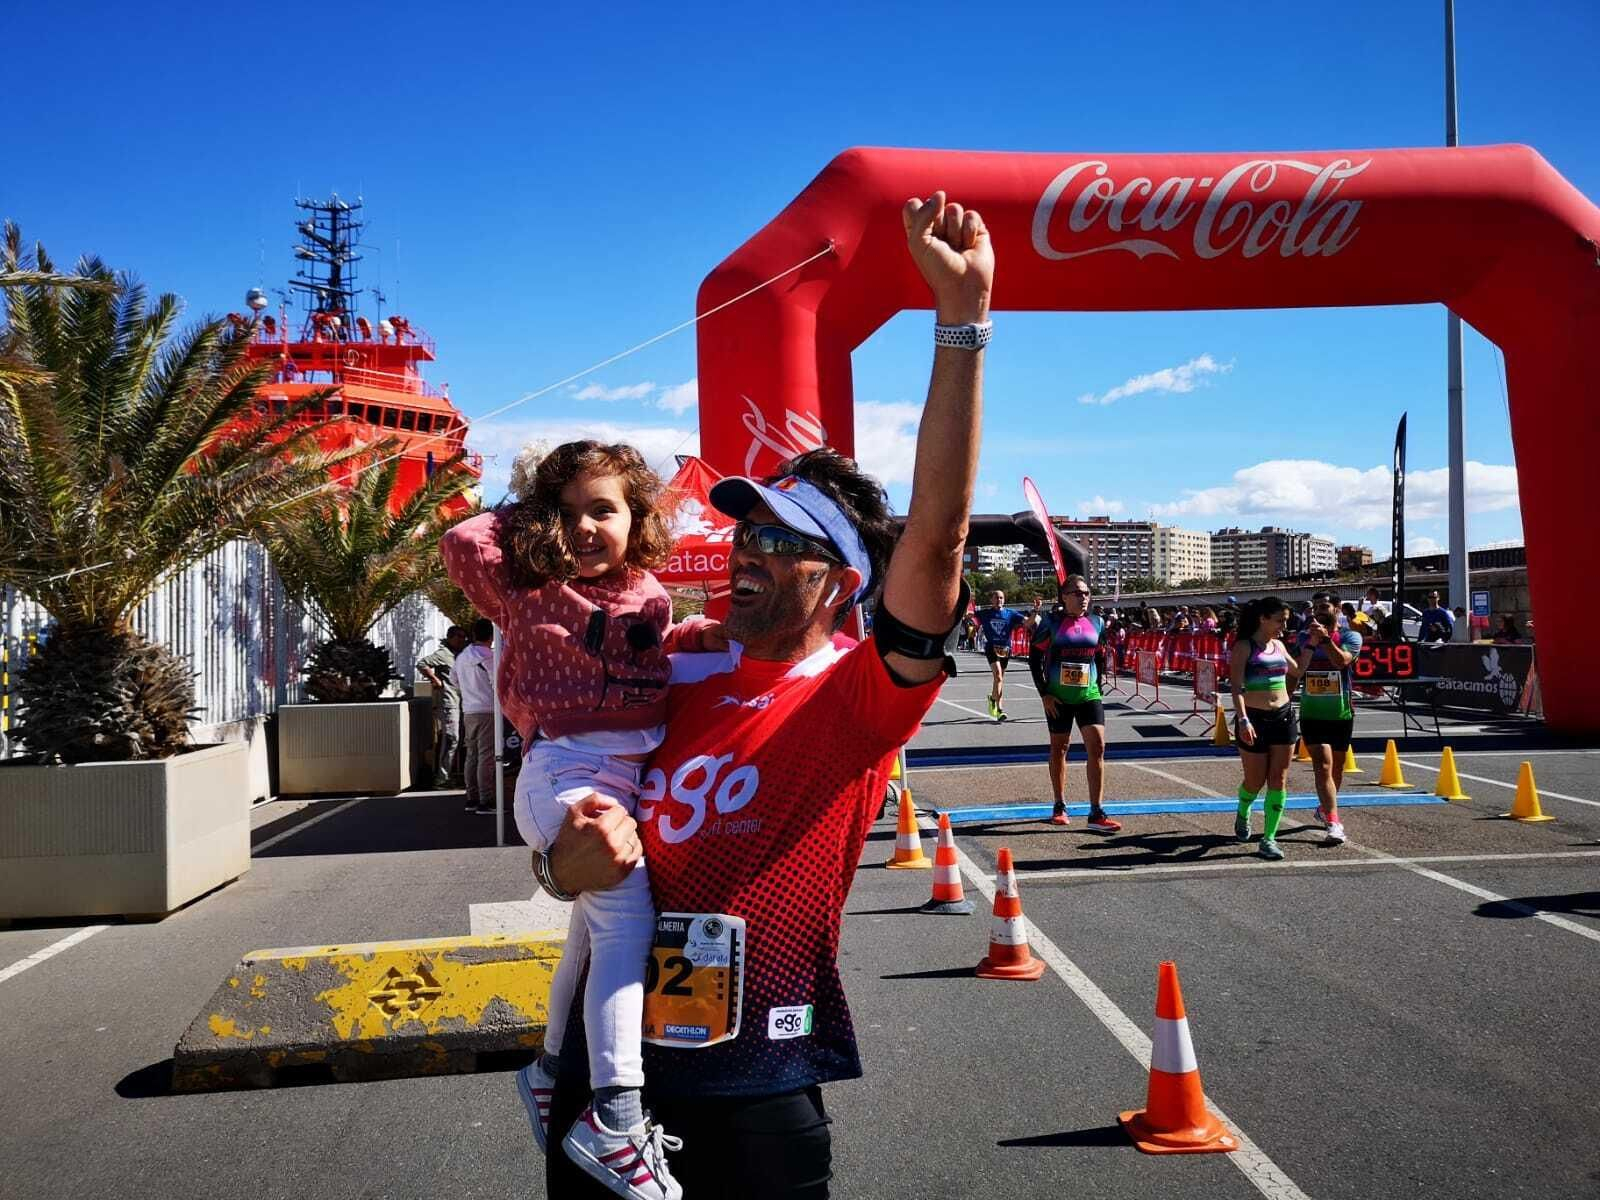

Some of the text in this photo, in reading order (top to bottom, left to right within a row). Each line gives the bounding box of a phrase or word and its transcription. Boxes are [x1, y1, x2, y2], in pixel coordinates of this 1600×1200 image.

[1031, 158, 1373, 261] Coca-Cola
[635, 752, 760, 845] ego
[775, 1013, 802, 1032] ego
